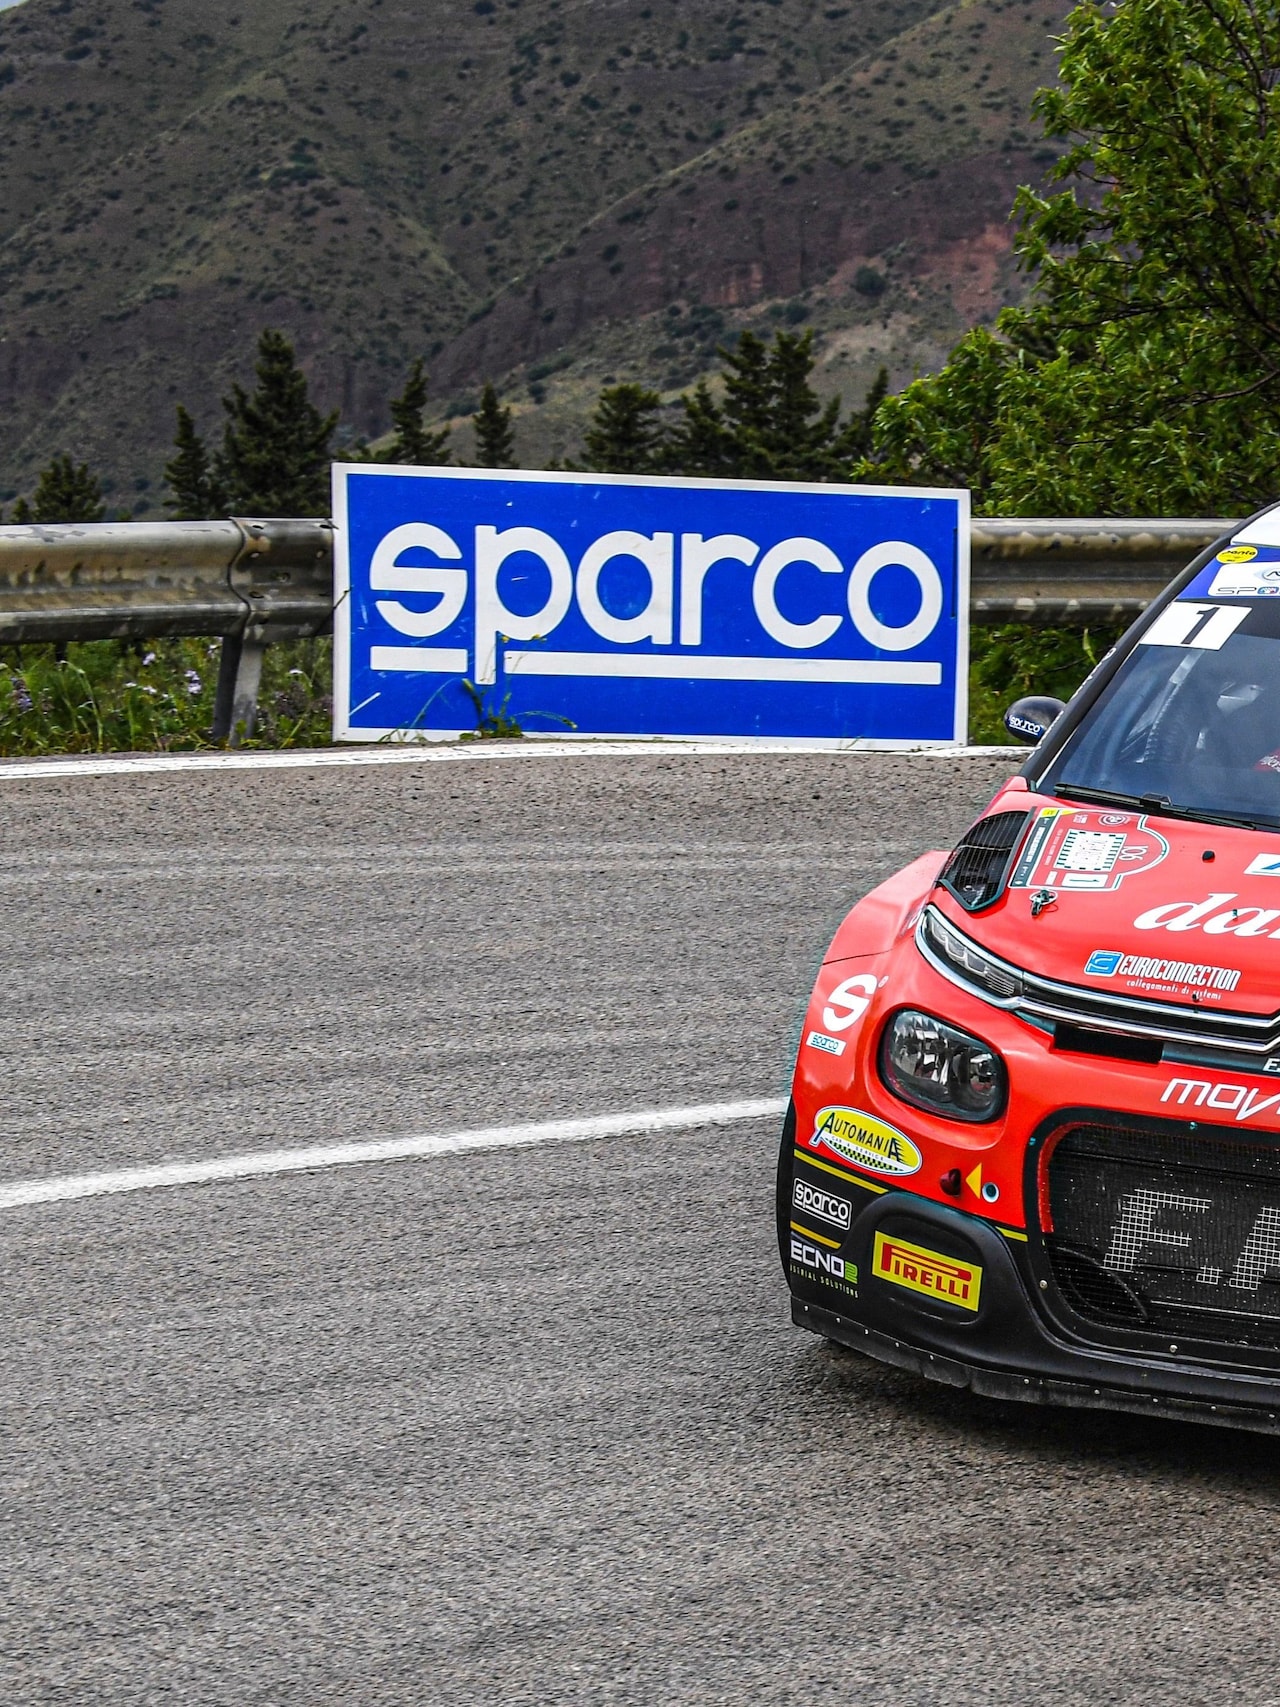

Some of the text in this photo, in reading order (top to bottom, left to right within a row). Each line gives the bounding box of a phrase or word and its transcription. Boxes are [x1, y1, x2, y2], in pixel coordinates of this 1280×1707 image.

[370, 521, 943, 685] sparco
[1181, 606, 1221, 645] 1
[1118, 954, 1242, 992] EUROCONNECTION
[1126, 978, 1179, 993] collegamenti
[1181, 985, 1190, 995] di
[794, 1183, 849, 1222] sparco
[790, 1239, 858, 1285] ECNO2
[881, 1241, 972, 1301] PIRELLI
